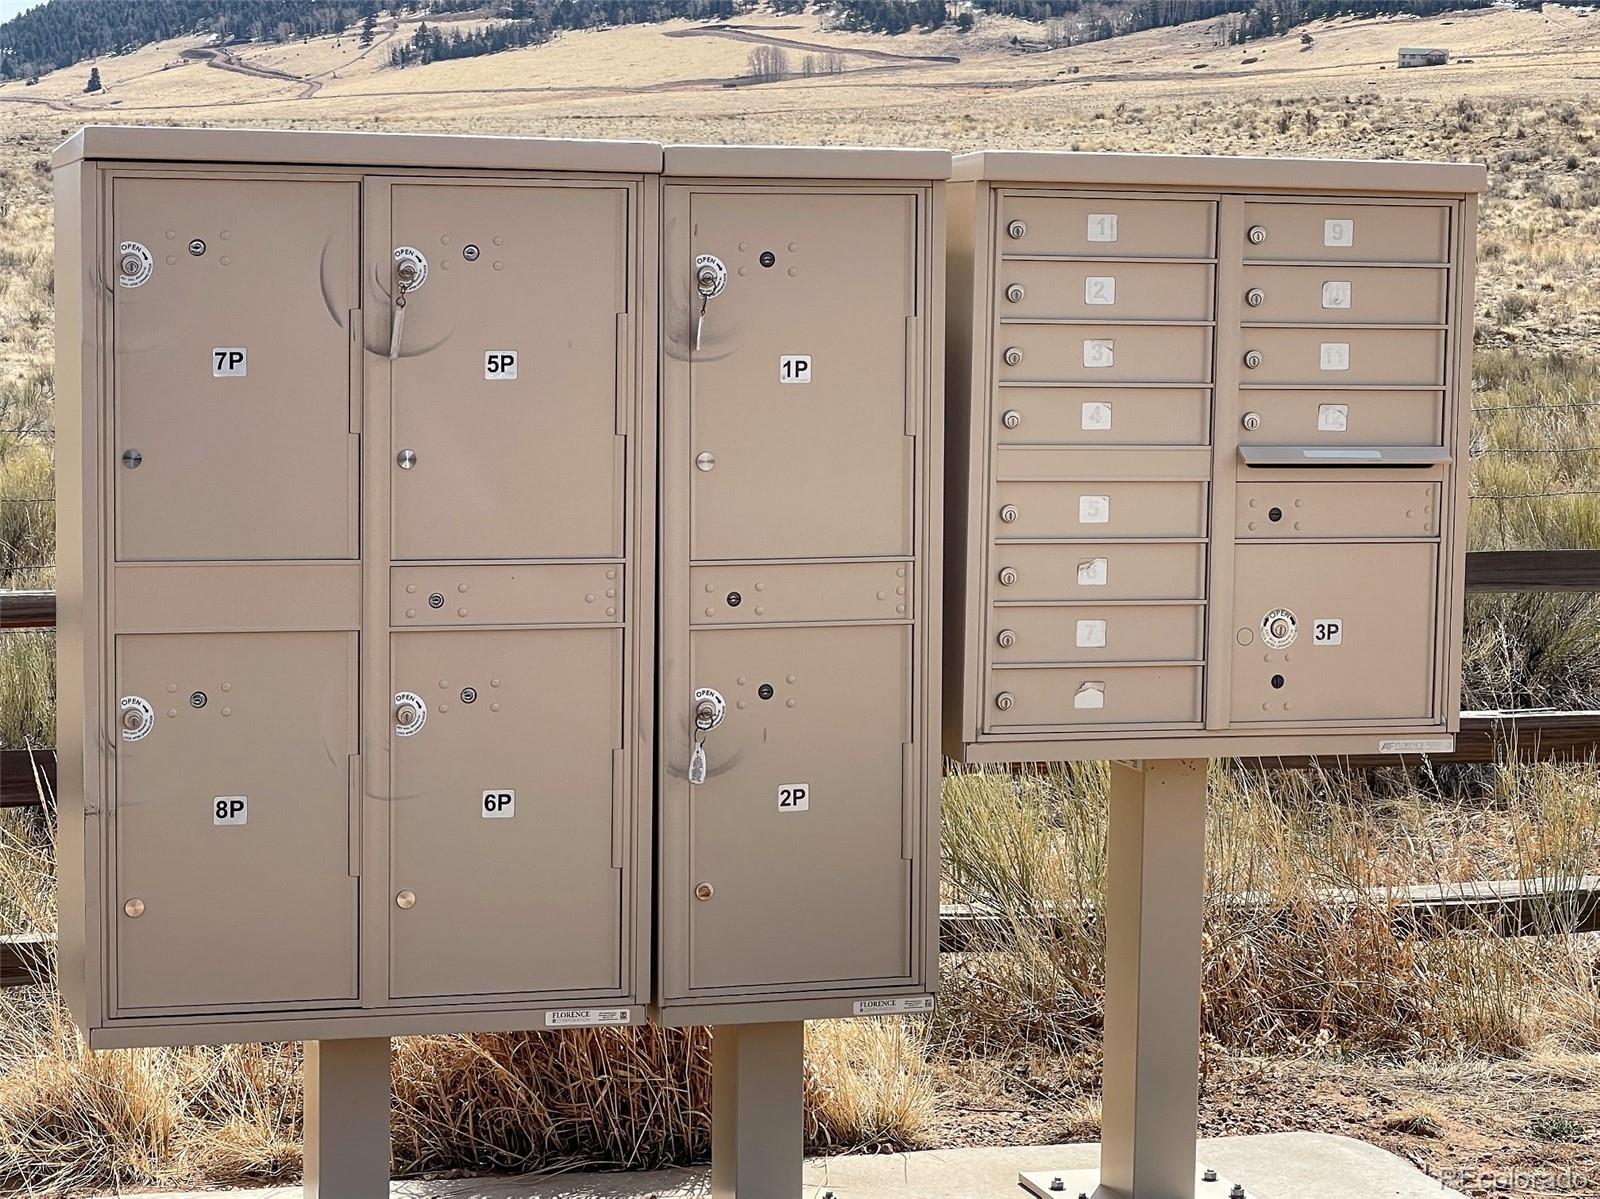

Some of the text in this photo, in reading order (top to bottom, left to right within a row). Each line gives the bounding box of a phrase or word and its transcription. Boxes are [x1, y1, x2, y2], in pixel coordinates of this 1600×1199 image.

[1096, 217, 1106, 236] 1
[1332, 223, 1344, 241] 9
[121, 243, 142, 252] OPEN
[394, 248, 415, 257] OPEN
[696, 256, 716, 265] OPEN
[1093, 280, 1106, 299] 2
[214, 351, 244, 370] 7P
[1091, 343, 1103, 361] 3
[487, 354, 514, 373] 5P
[782, 360, 808, 378] 1P
[1089, 405, 1101, 424] 4
[1087, 500, 1099, 517] 5
[1269, 609, 1291, 619] OPEN
[1085, 624, 1096, 641] 7
[1315, 623, 1339, 641] 3P
[121, 697, 142, 707] OPEN
[395, 693, 415, 702] OPEN
[695, 689, 715, 698] OPEN
[484, 794, 512, 812] 6P
[780, 788, 806, 807] 2P
[215, 800, 244, 818] 8P
[859, 1000, 897, 1008] FLORENCE
[552, 1010, 590, 1019] FLORENCE
